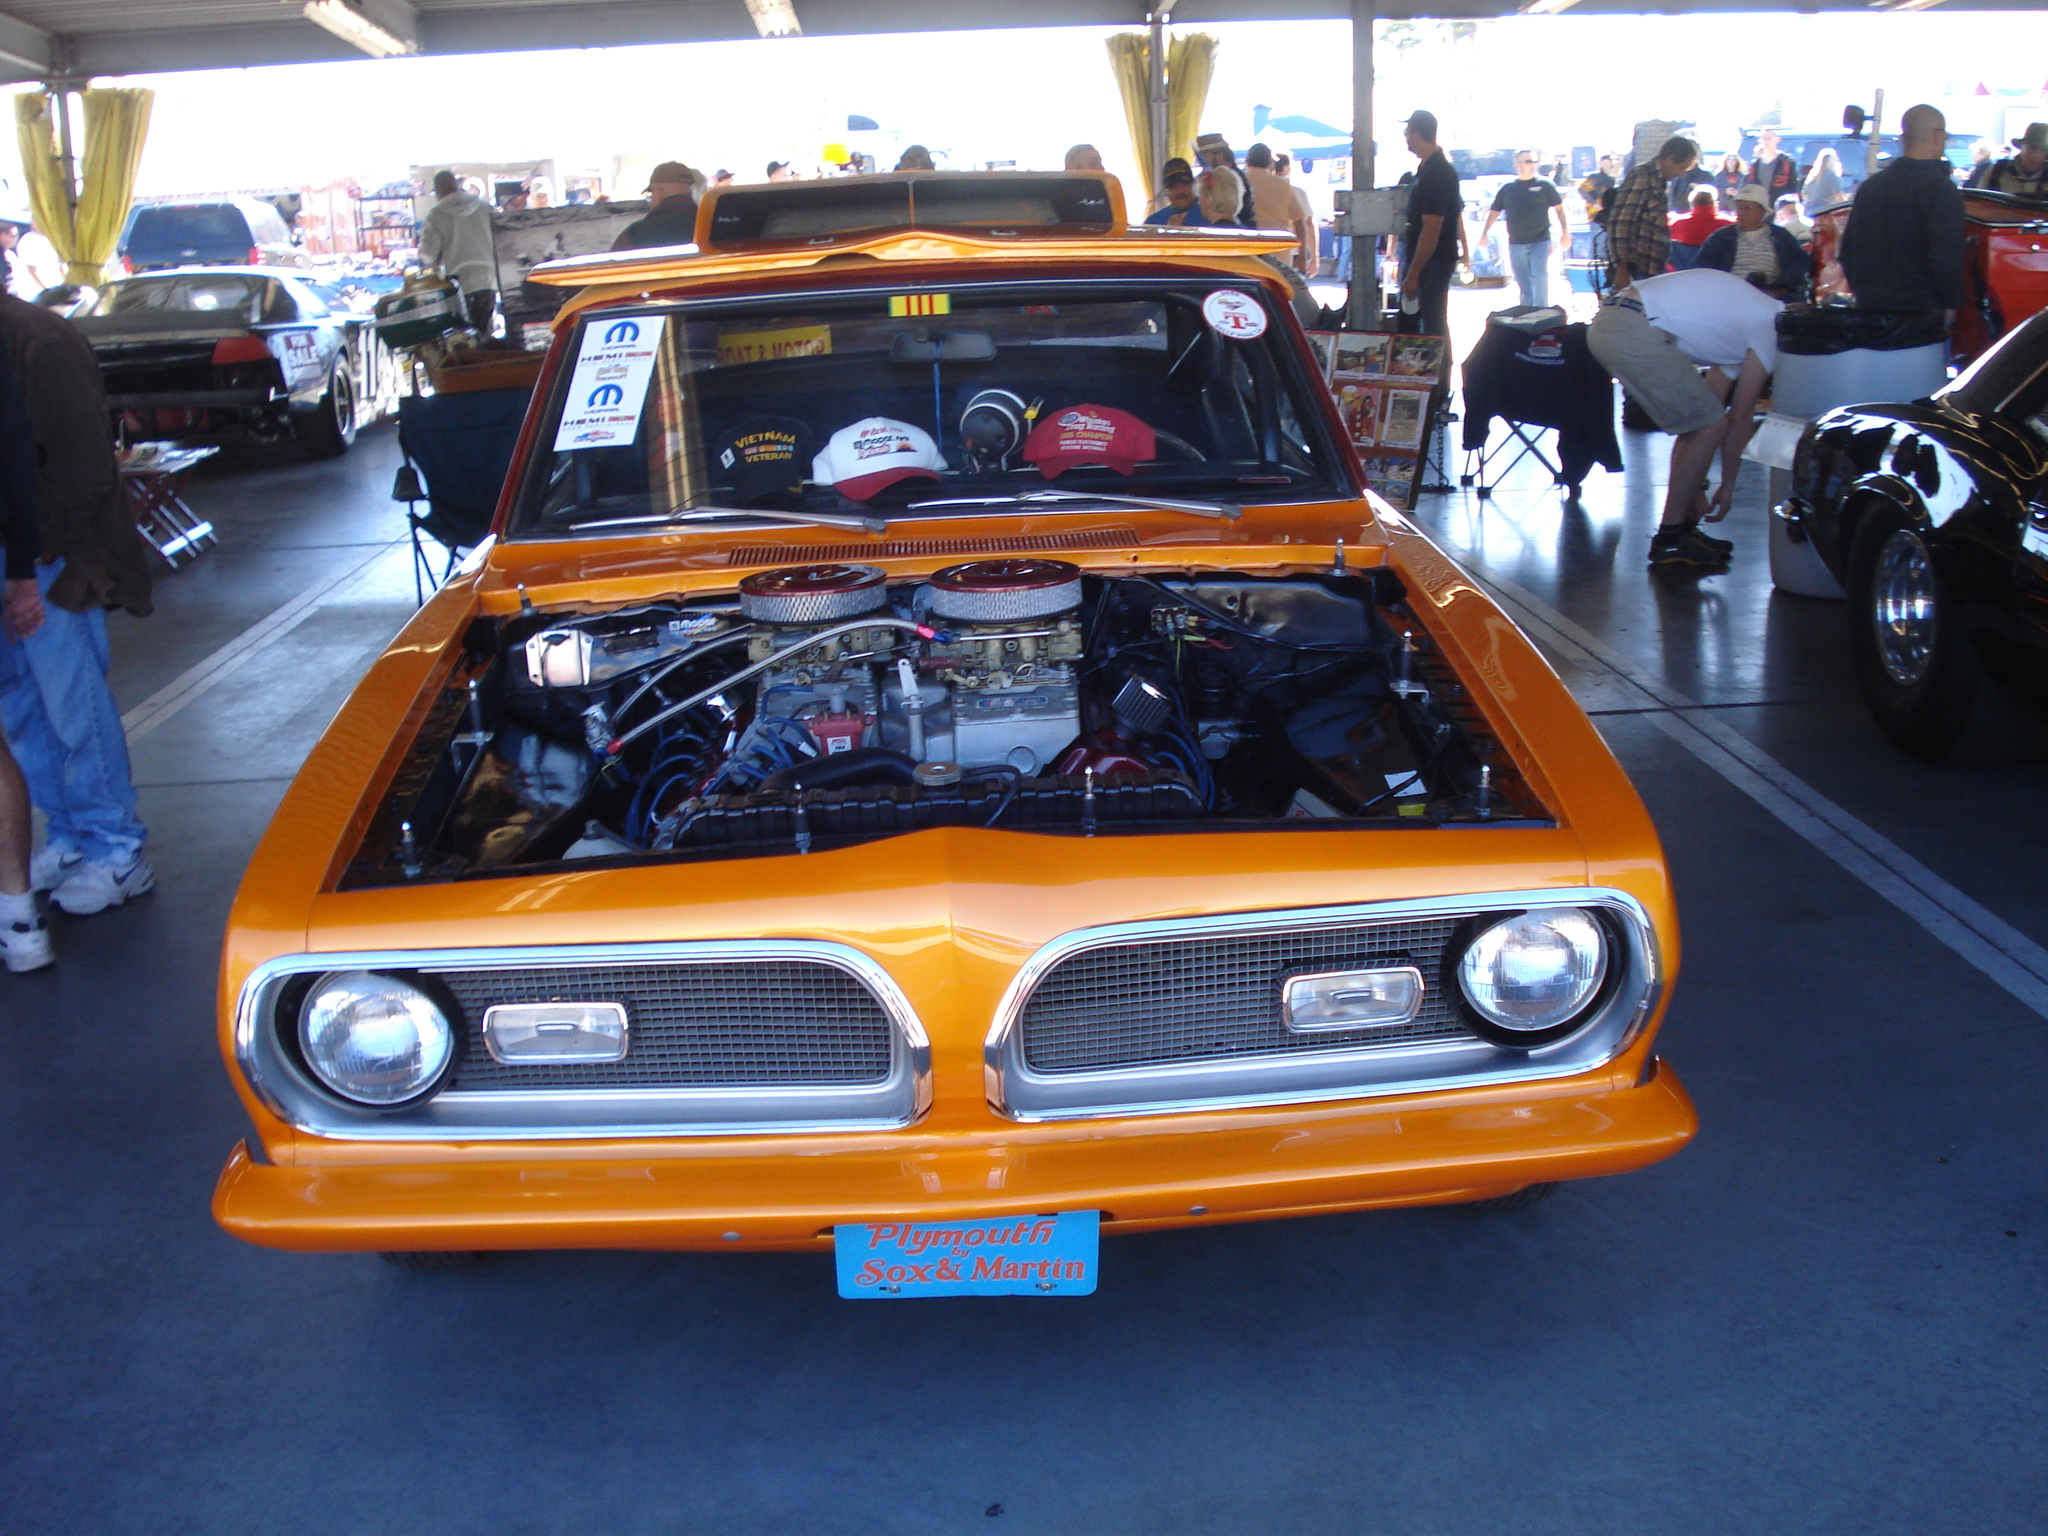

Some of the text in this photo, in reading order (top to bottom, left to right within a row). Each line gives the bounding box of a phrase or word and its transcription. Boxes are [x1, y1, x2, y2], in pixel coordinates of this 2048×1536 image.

[580, 352, 624, 363] HEMI
[563, 416, 606, 427] HEMI
[734, 430, 796, 449] VIETNAM
[744, 452, 793, 464] VETERAN
[866, 1219, 1058, 1256] Plymouth
[951, 1247, 970, 1258] by
[970, 1255, 1085, 1282] Martin
